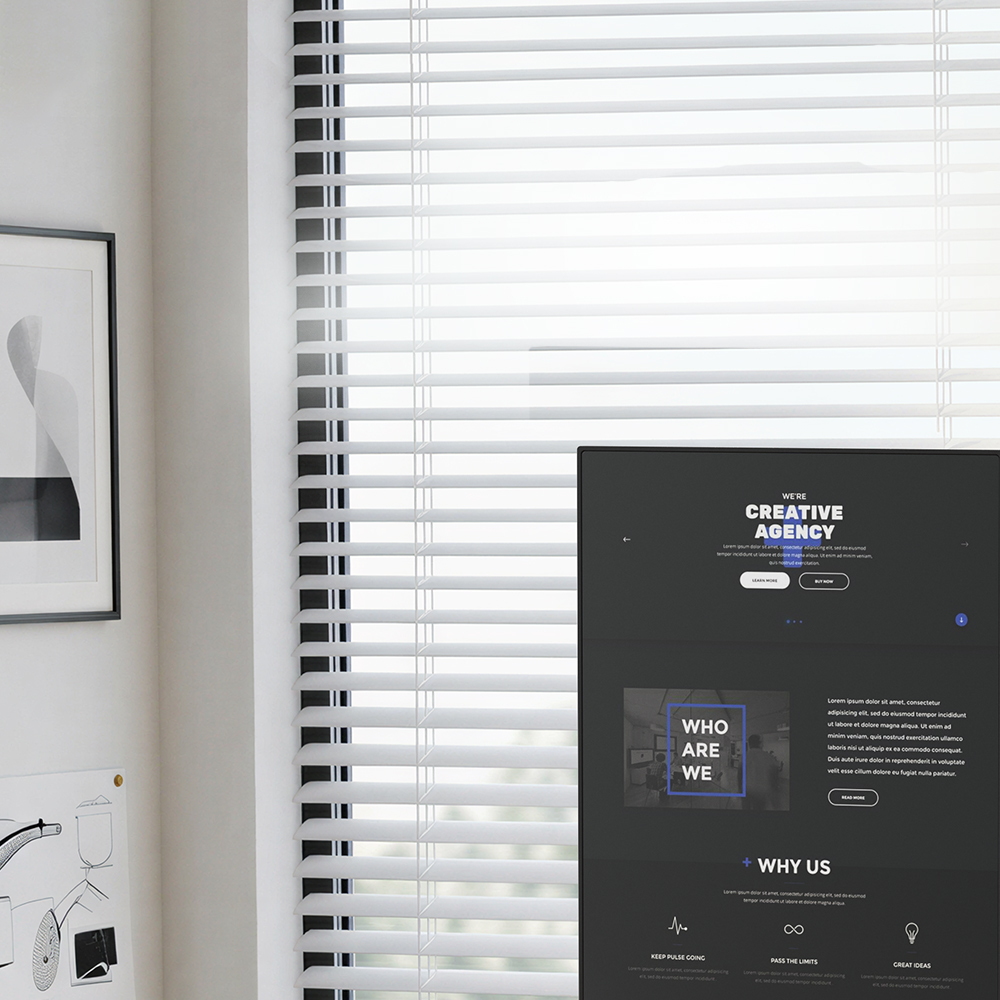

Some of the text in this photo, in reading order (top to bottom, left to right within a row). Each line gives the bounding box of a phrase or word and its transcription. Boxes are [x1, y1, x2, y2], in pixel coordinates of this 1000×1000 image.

[746, 504, 843, 520] CREATIVE
[755, 524, 835, 540] AGENCY
[682, 719, 728, 735] WHO
[682, 742, 720, 758] ARE
[682, 766, 712, 780] WE
[758, 858, 831, 875] WHY US
